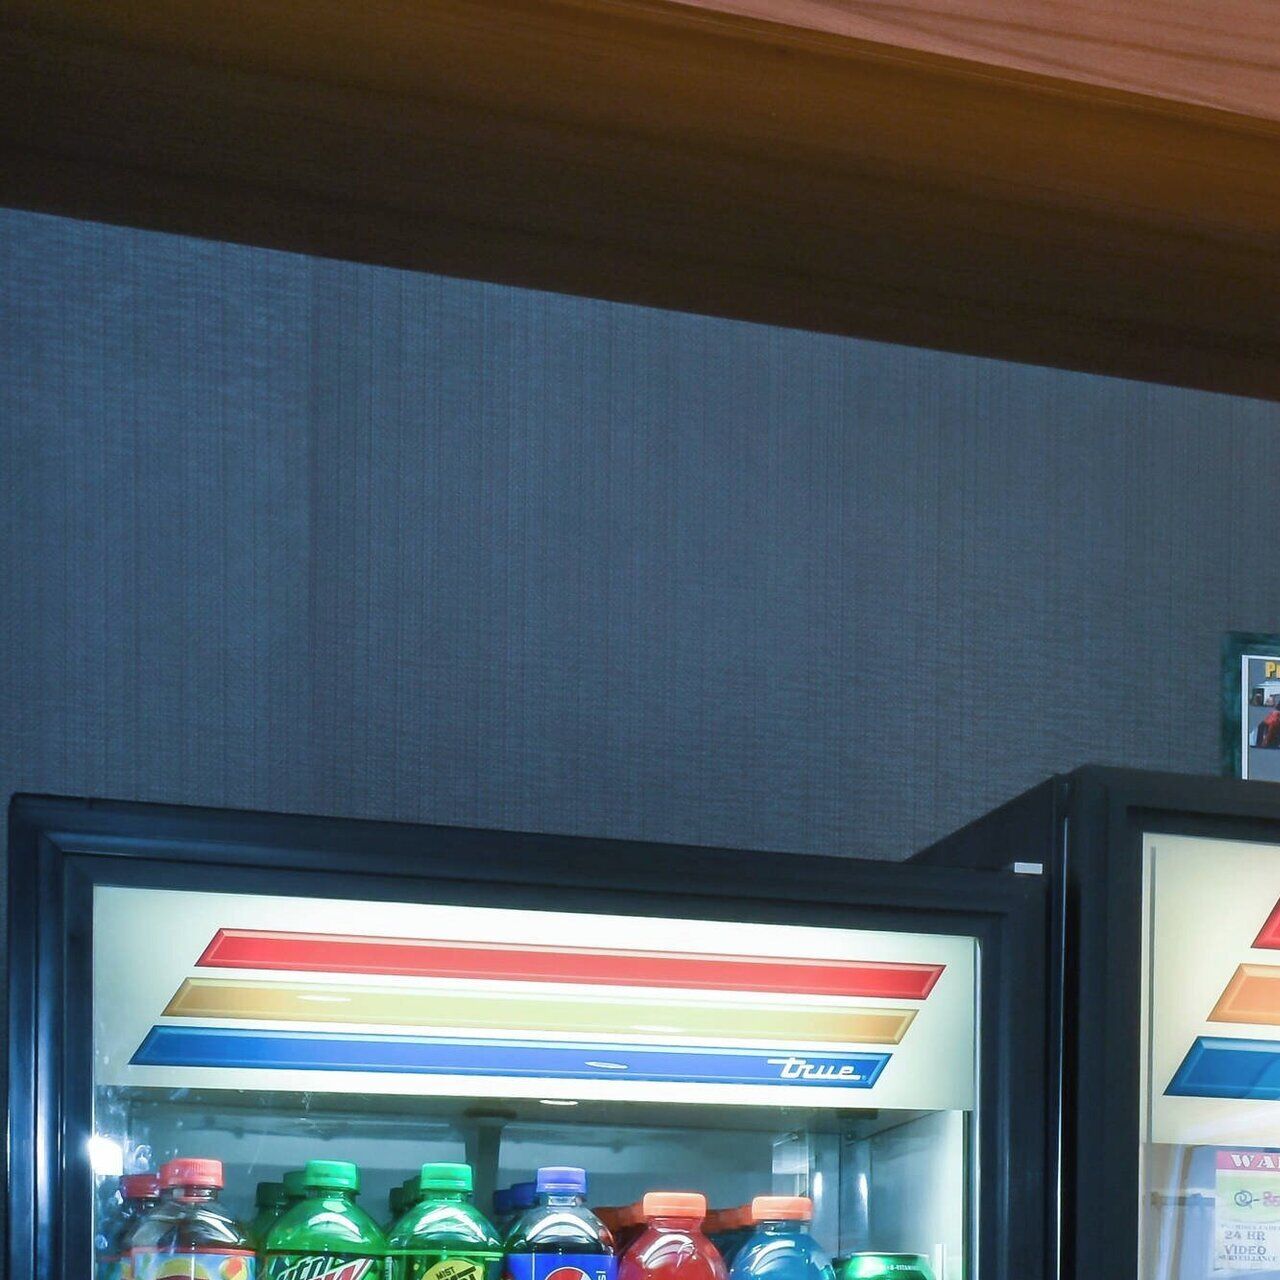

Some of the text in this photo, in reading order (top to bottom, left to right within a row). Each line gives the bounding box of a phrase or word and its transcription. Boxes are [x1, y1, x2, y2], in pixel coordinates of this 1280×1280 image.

[767, 1057, 861, 1080] true
[1224, 1230, 1242, 1240] 24
[1224, 1244, 1267, 1256] VIDEO
[435, 1267, 456, 1280] MIST
